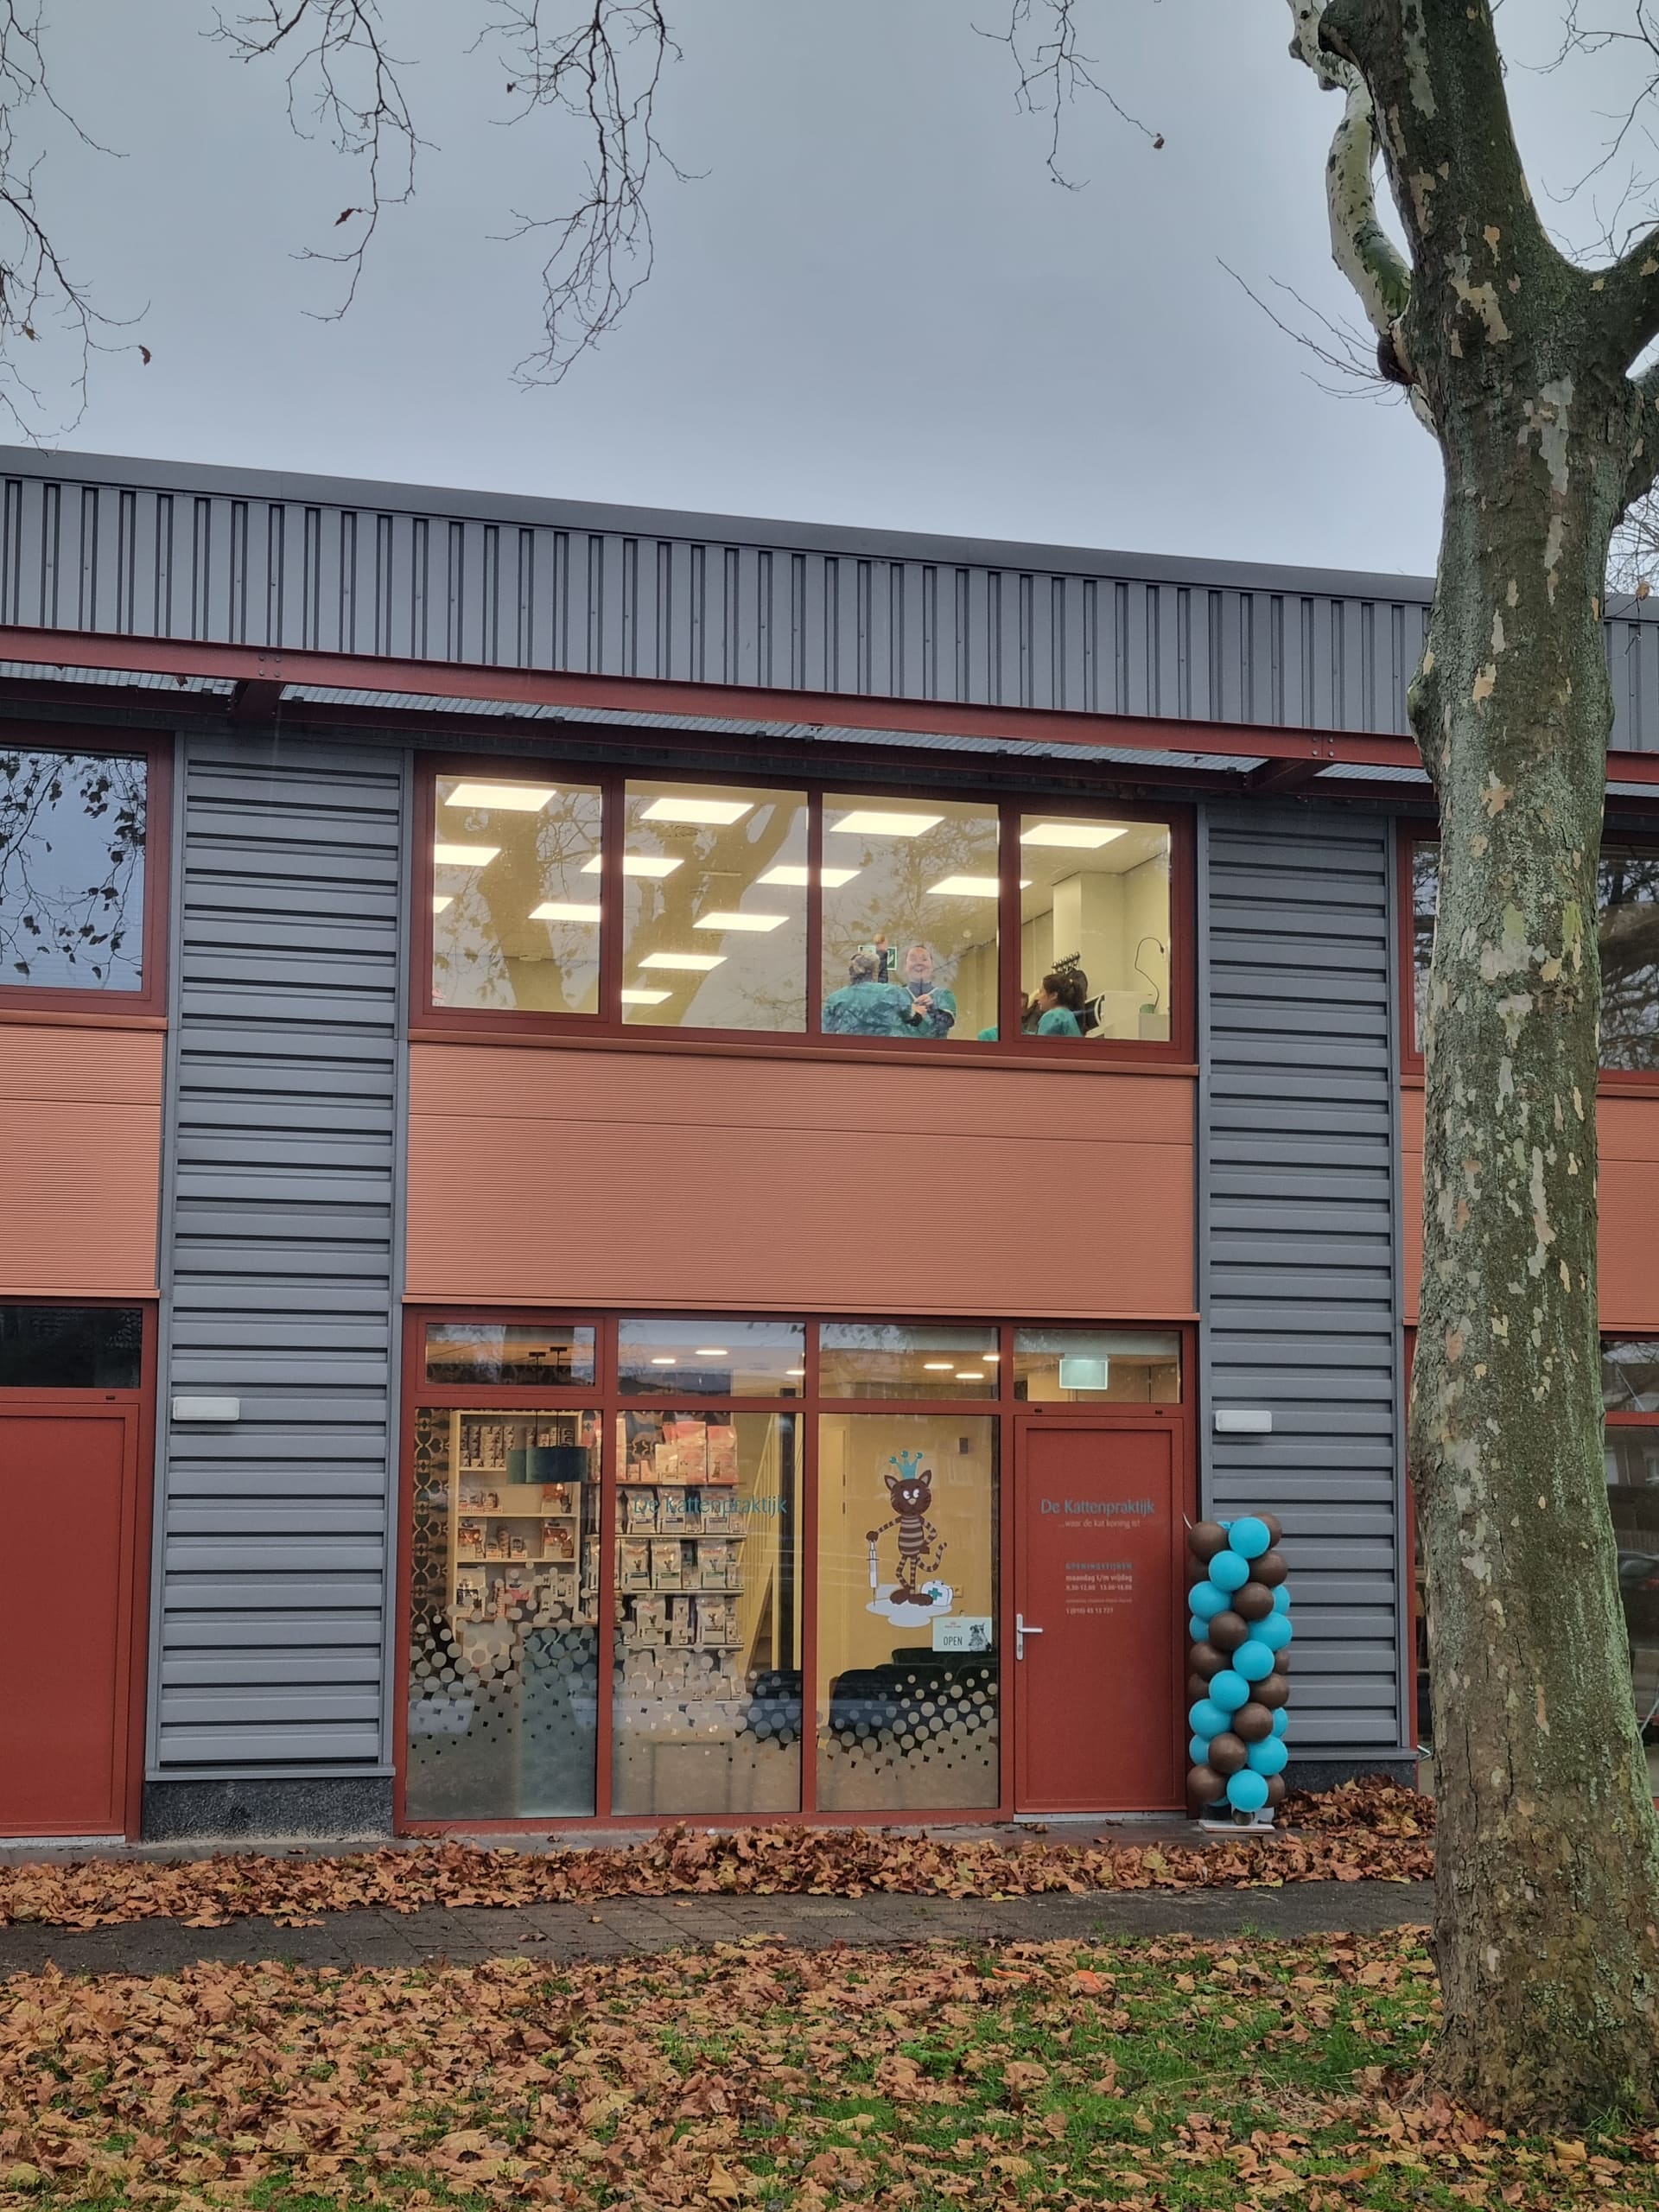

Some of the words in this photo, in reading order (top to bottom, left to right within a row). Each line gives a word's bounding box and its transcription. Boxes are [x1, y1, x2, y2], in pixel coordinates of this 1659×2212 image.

[634, 1497, 658, 1513] De
[665, 1496, 787, 1518] Kattenpraktijk
[1041, 1498, 1060, 1514] De
[1064, 1497, 1154, 1517] Kattenpraktijk
[943, 1636, 963, 1646] OPEN
